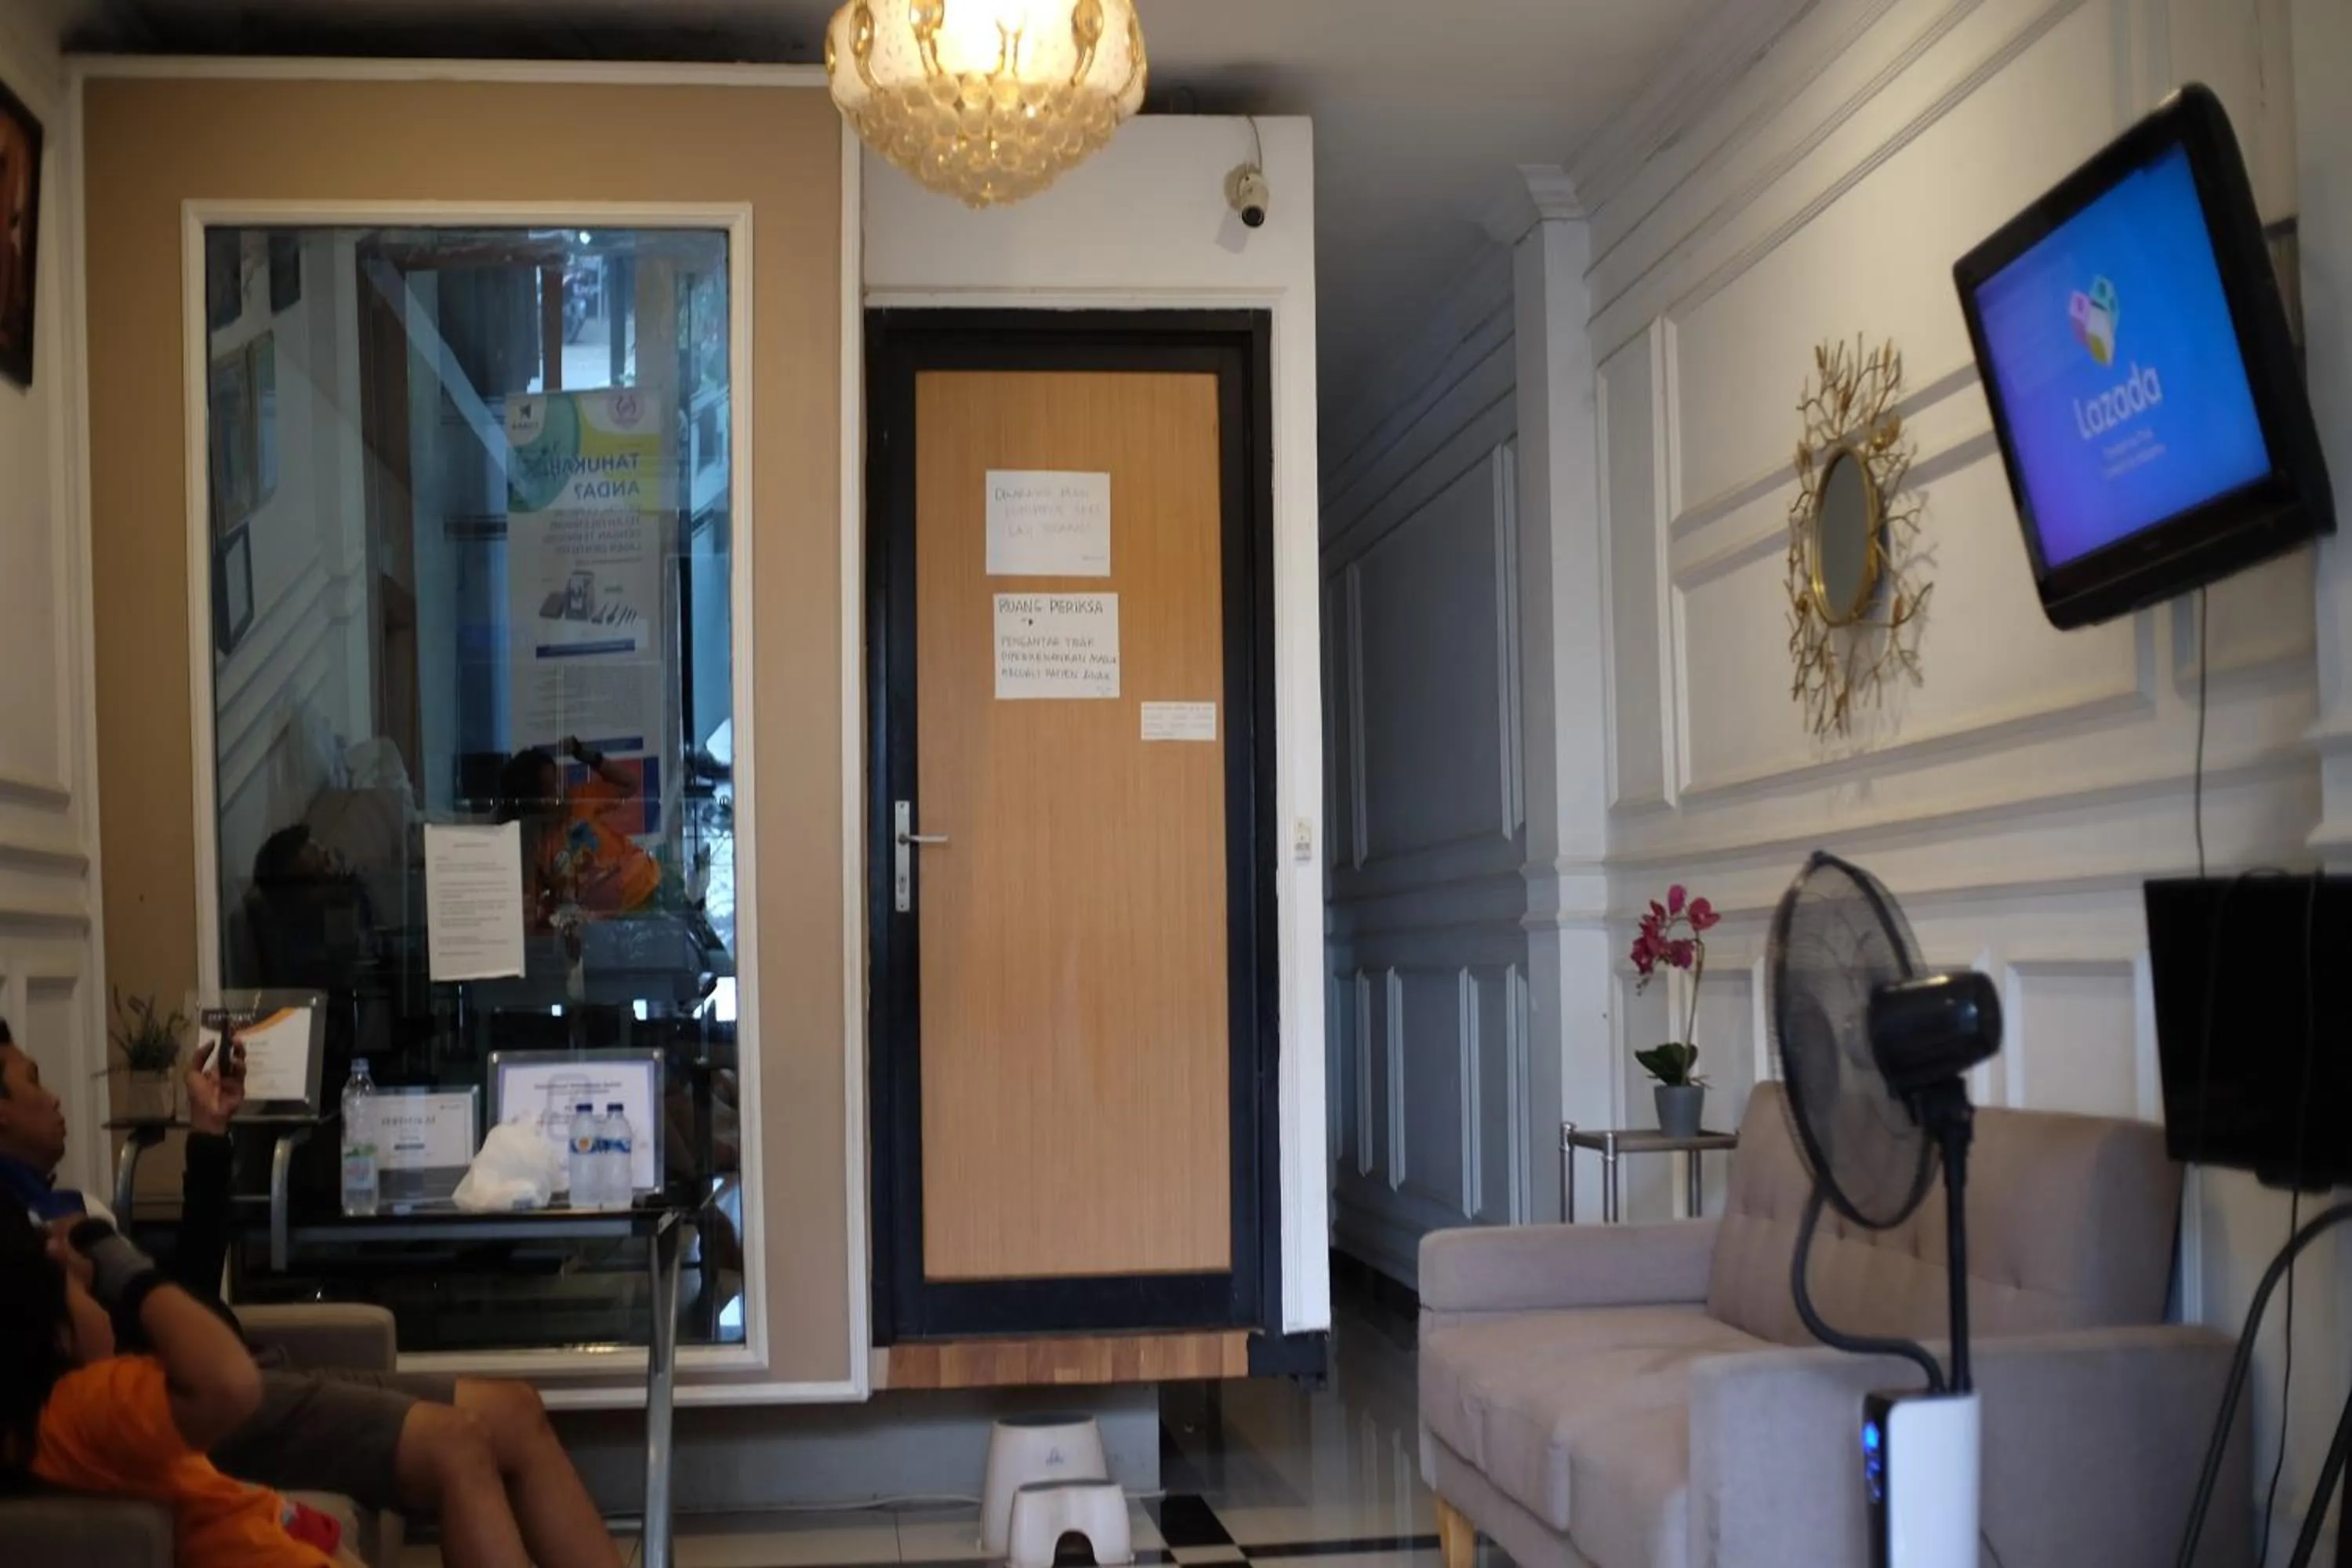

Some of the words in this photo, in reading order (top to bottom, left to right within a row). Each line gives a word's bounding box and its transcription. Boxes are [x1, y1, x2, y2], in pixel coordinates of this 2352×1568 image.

[2074, 361, 2162, 440] Lazada
[998, 598, 1043, 615] RUANG
[1050, 599, 1104, 615] PERIKSA
